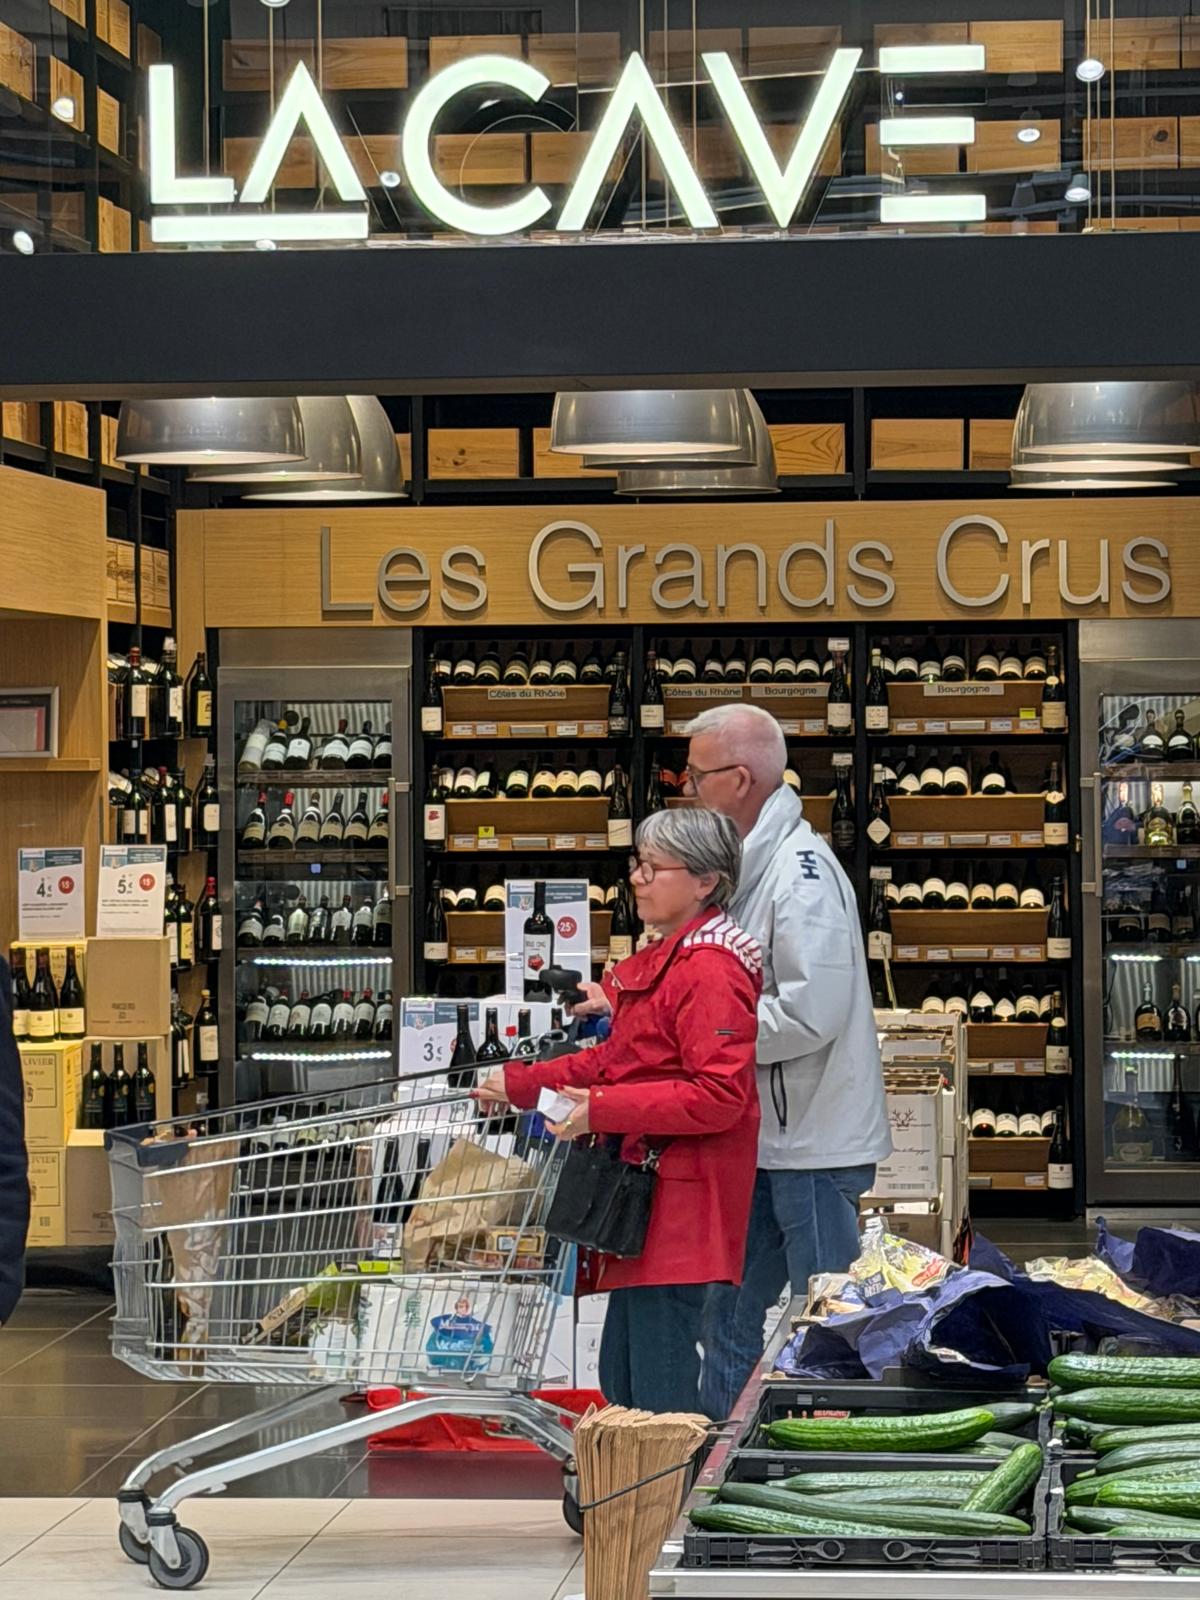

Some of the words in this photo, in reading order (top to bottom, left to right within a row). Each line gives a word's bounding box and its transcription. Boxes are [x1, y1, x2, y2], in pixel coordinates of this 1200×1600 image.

[148, 60, 366, 205] LA
[402, 45, 986, 235] CAVE
[320, 526, 488, 616] Les
[528, 518, 895, 612] Grands
[936, 514, 1171, 608] Crus
[489, 687, 517, 698] Côtes
[521, 688, 532, 698] du
[535, 687, 565, 697] Rhône
[664, 687, 693, 697] Côtes
[695, 687, 707, 697] du
[709, 686, 742, 696] Rhône
[765, 685, 817, 697] Bourgogne
[937, 684, 990, 695] Bourgogne
[423, 1043, 434, 1062] 3
